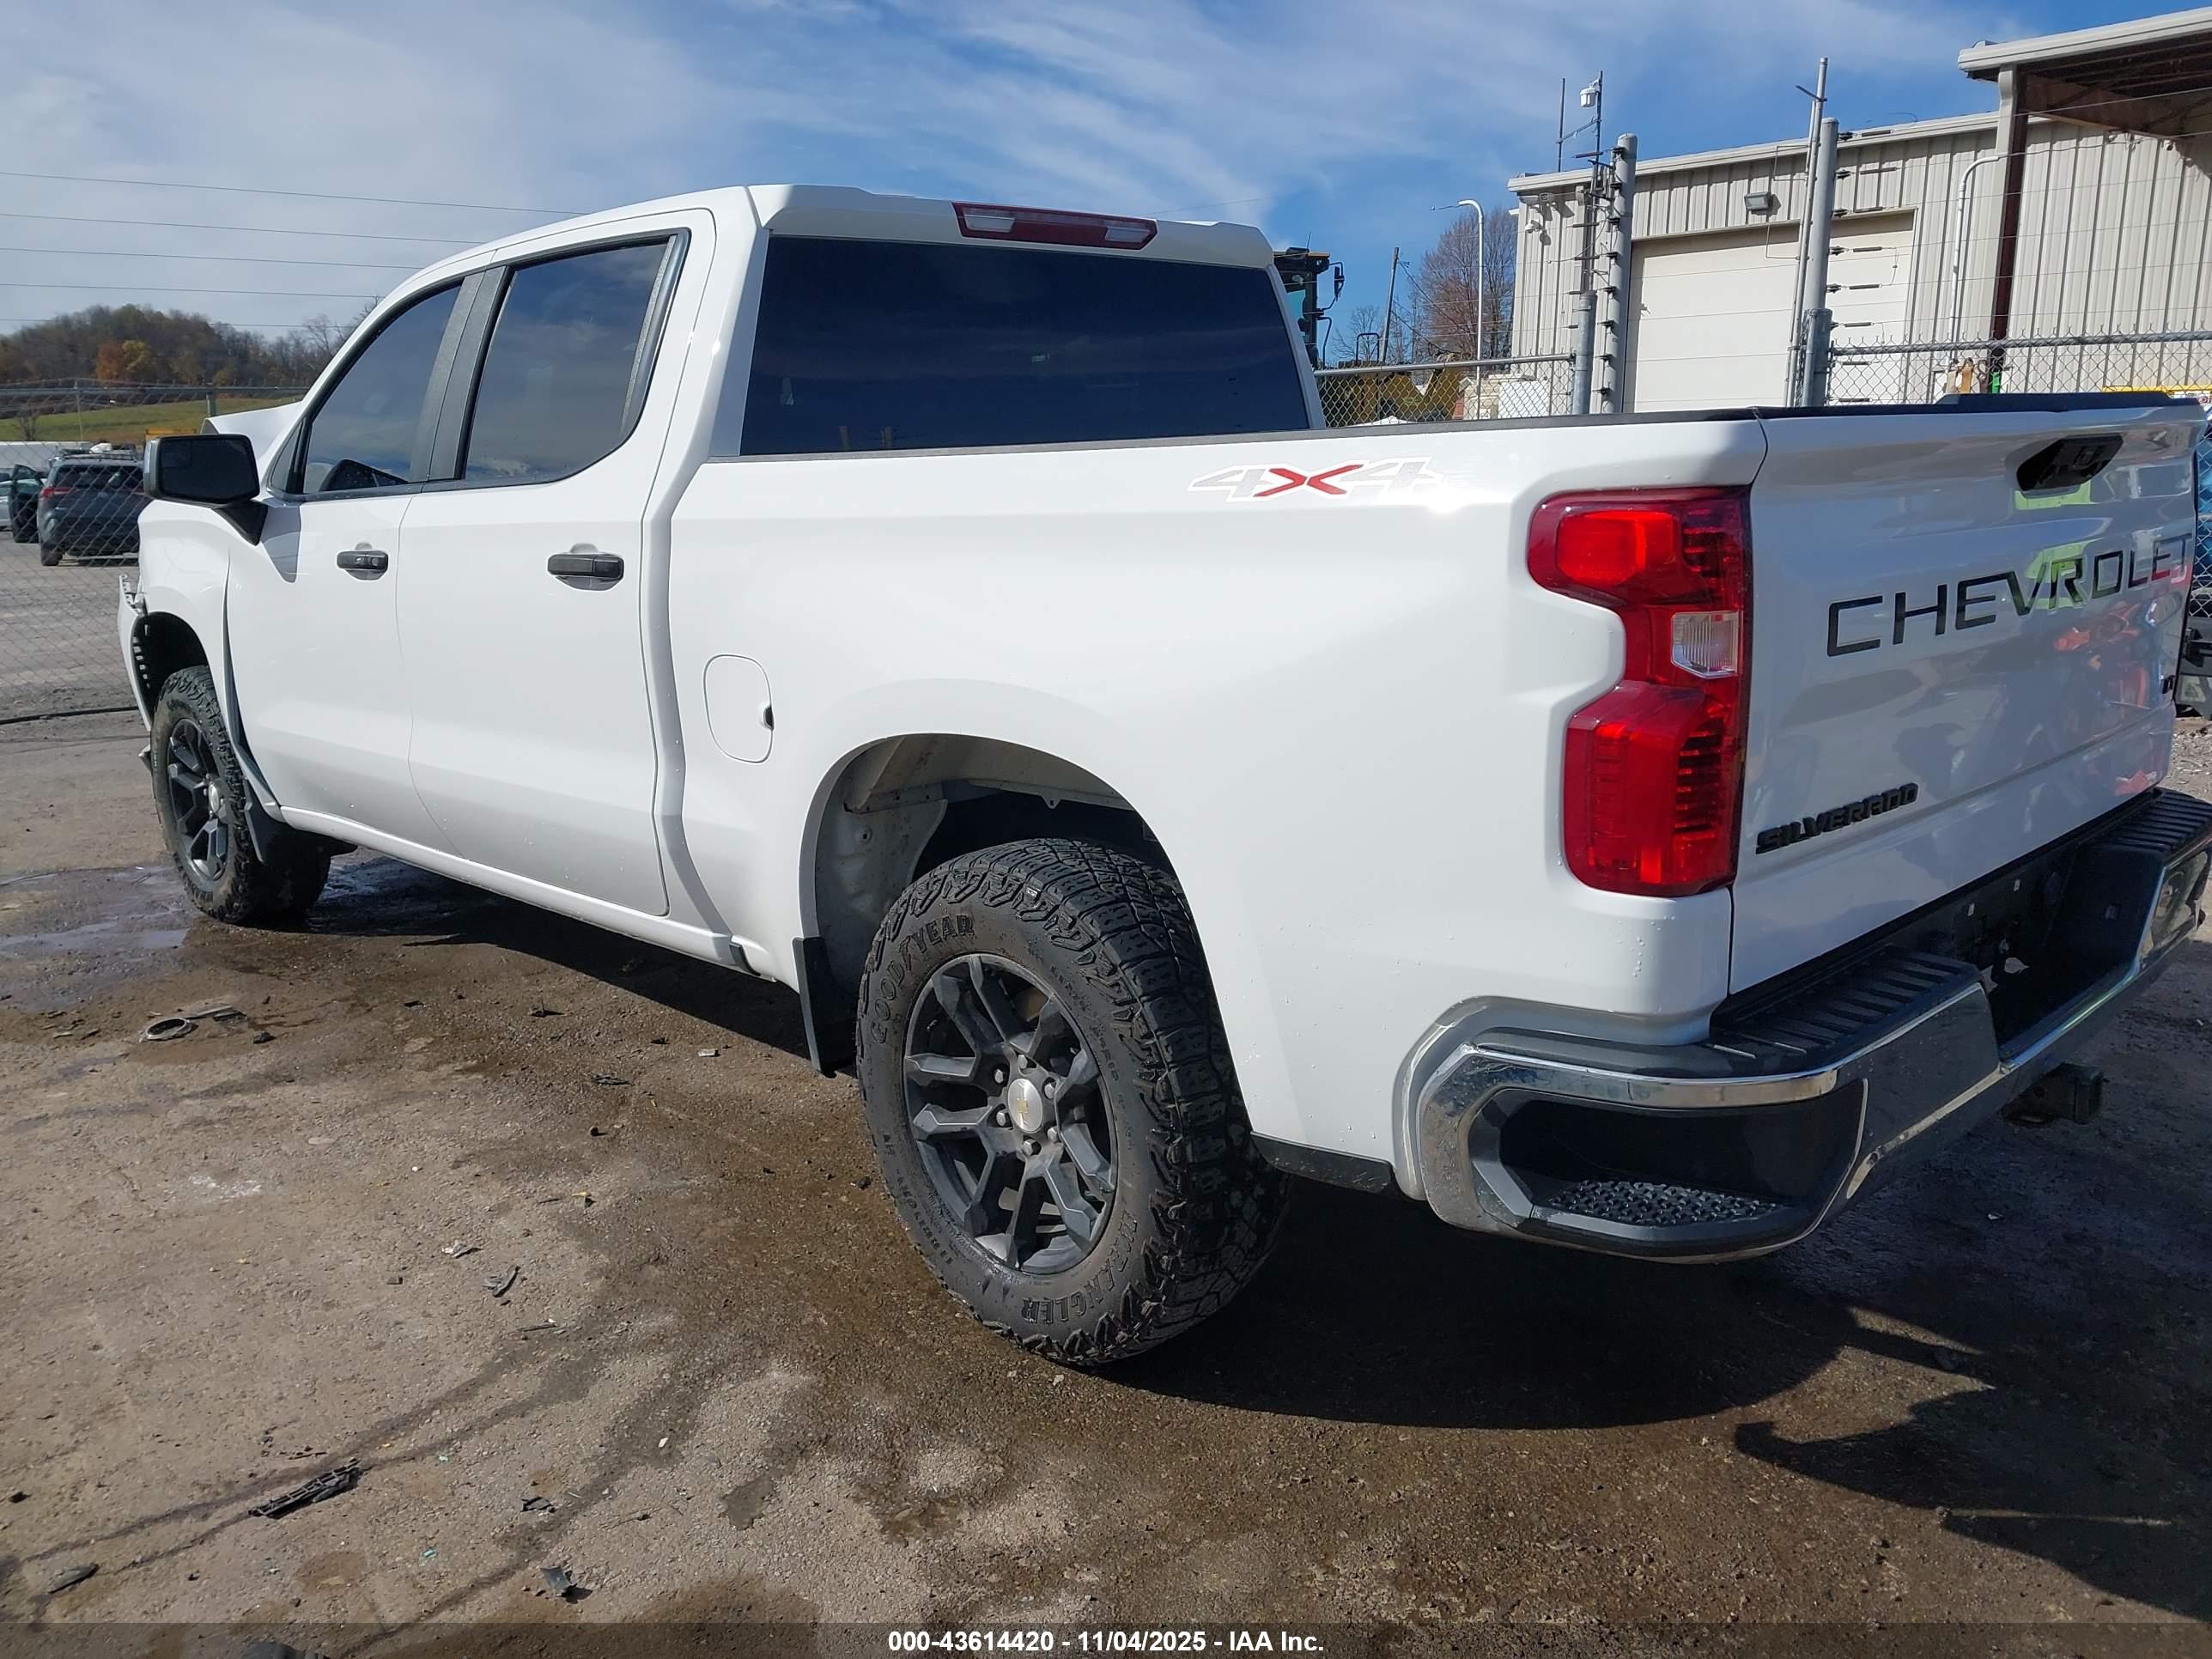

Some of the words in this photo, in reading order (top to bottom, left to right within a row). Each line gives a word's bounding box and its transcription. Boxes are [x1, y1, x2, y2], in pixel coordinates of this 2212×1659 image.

[1827, 532, 2192, 657] CHEVROLET
[1755, 781, 1918, 855] SILVERADO
[871, 913, 975, 1044] GOODYEAR
